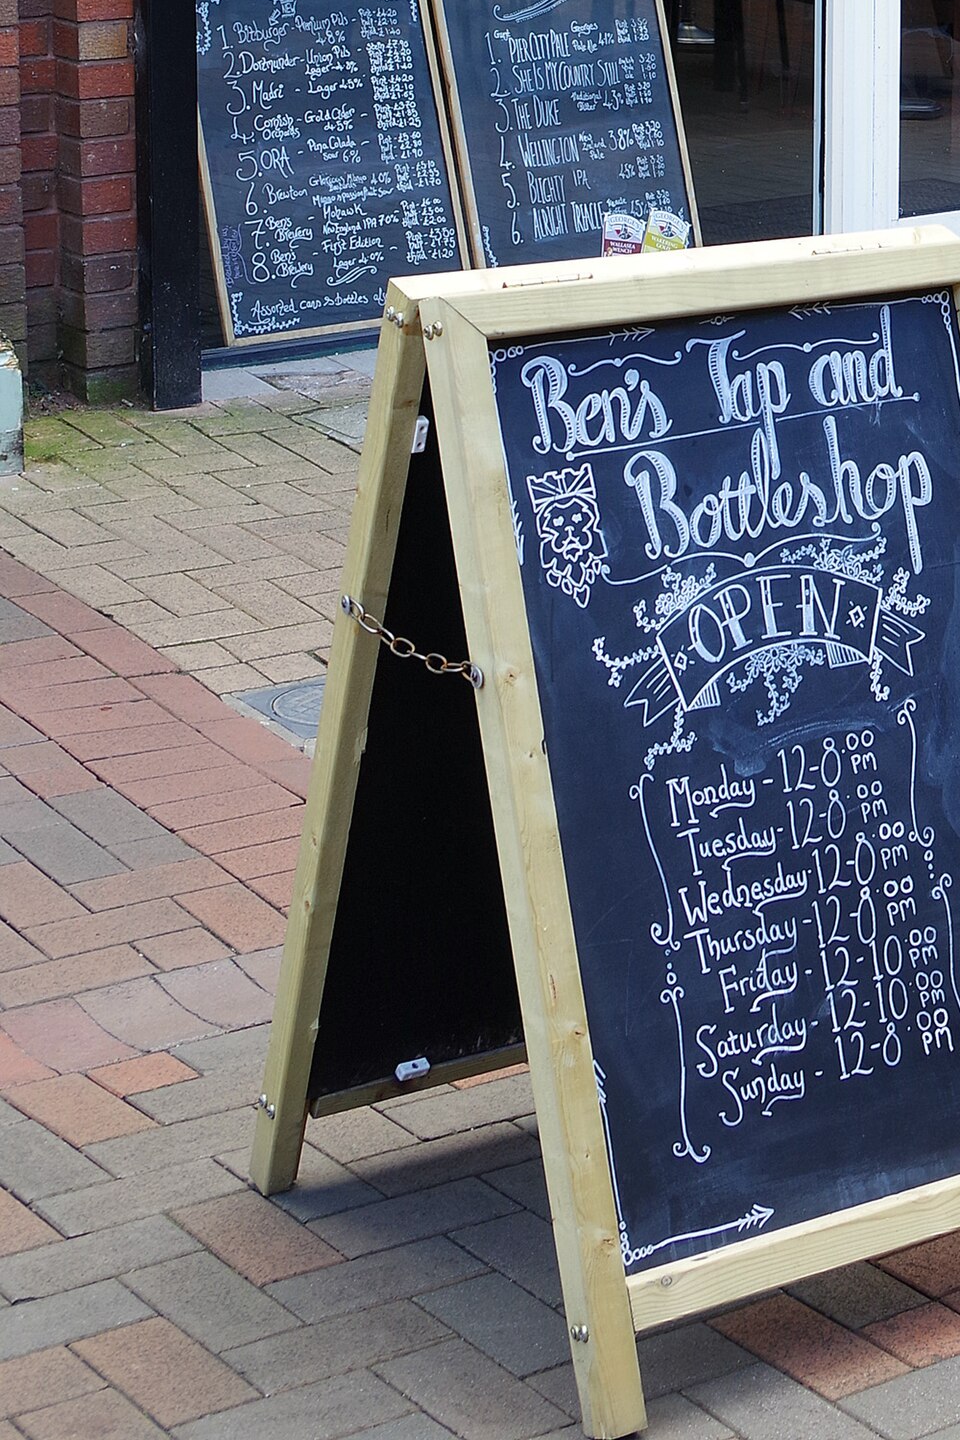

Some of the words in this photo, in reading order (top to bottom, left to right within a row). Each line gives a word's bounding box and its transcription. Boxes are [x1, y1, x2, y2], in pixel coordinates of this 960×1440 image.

[233, 21, 289, 51] Bitburger
[252, 80, 286, 110] Madri
[533, 94, 561, 128] DUKE
[518, 134, 580, 168] WELLINGTON
[521, 356, 673, 453] Ben's
[686, 330, 791, 479] Tap
[808, 305, 903, 406] and
[624, 416, 932, 574] Bottleshop
[688, 574, 846, 662] OPEN
